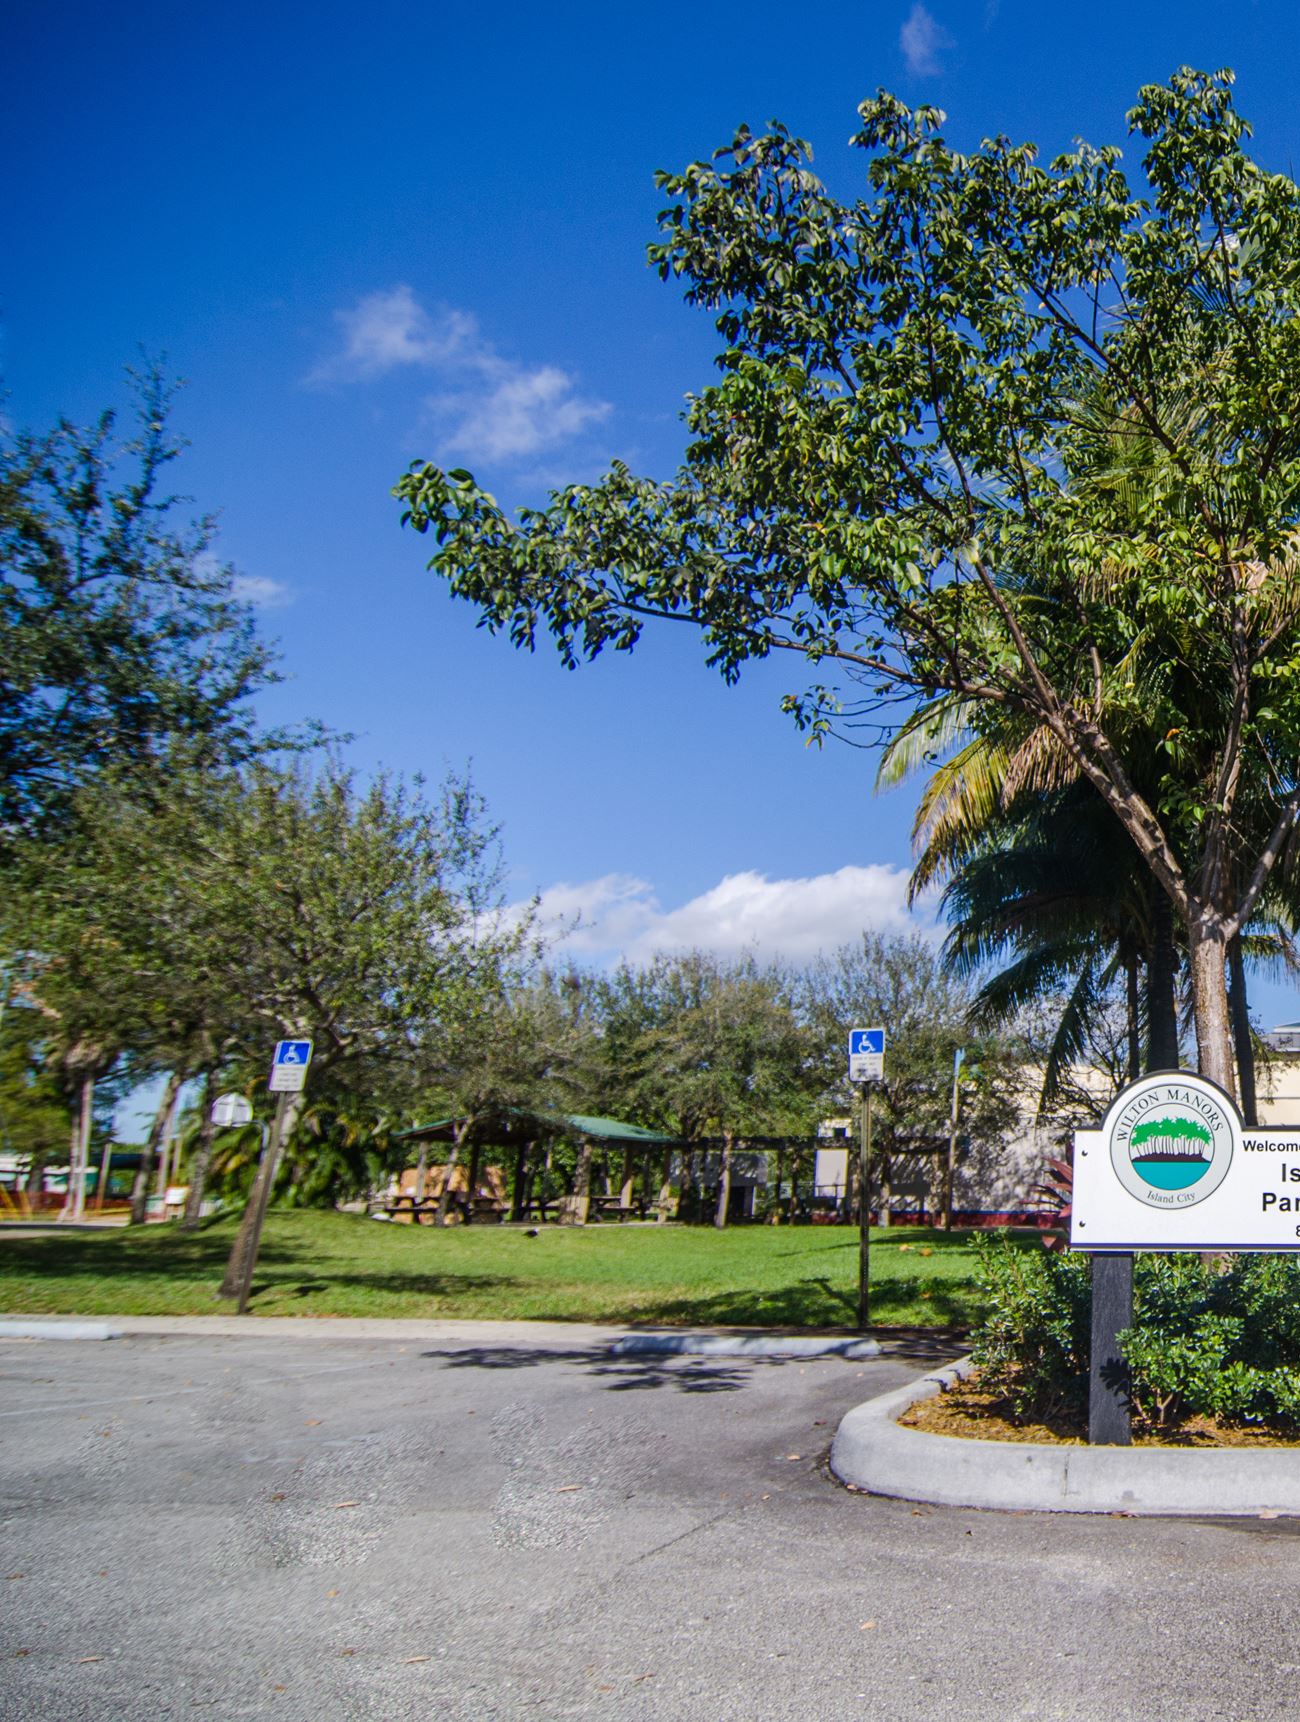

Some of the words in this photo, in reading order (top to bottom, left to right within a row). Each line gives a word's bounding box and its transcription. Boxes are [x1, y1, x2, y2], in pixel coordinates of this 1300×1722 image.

[1117, 1092, 1159, 1141] WILTON
[1167, 1089, 1223, 1132] MANORS
[1147, 1190, 1174, 1204] Island
[1176, 1192, 1195, 1203] City
